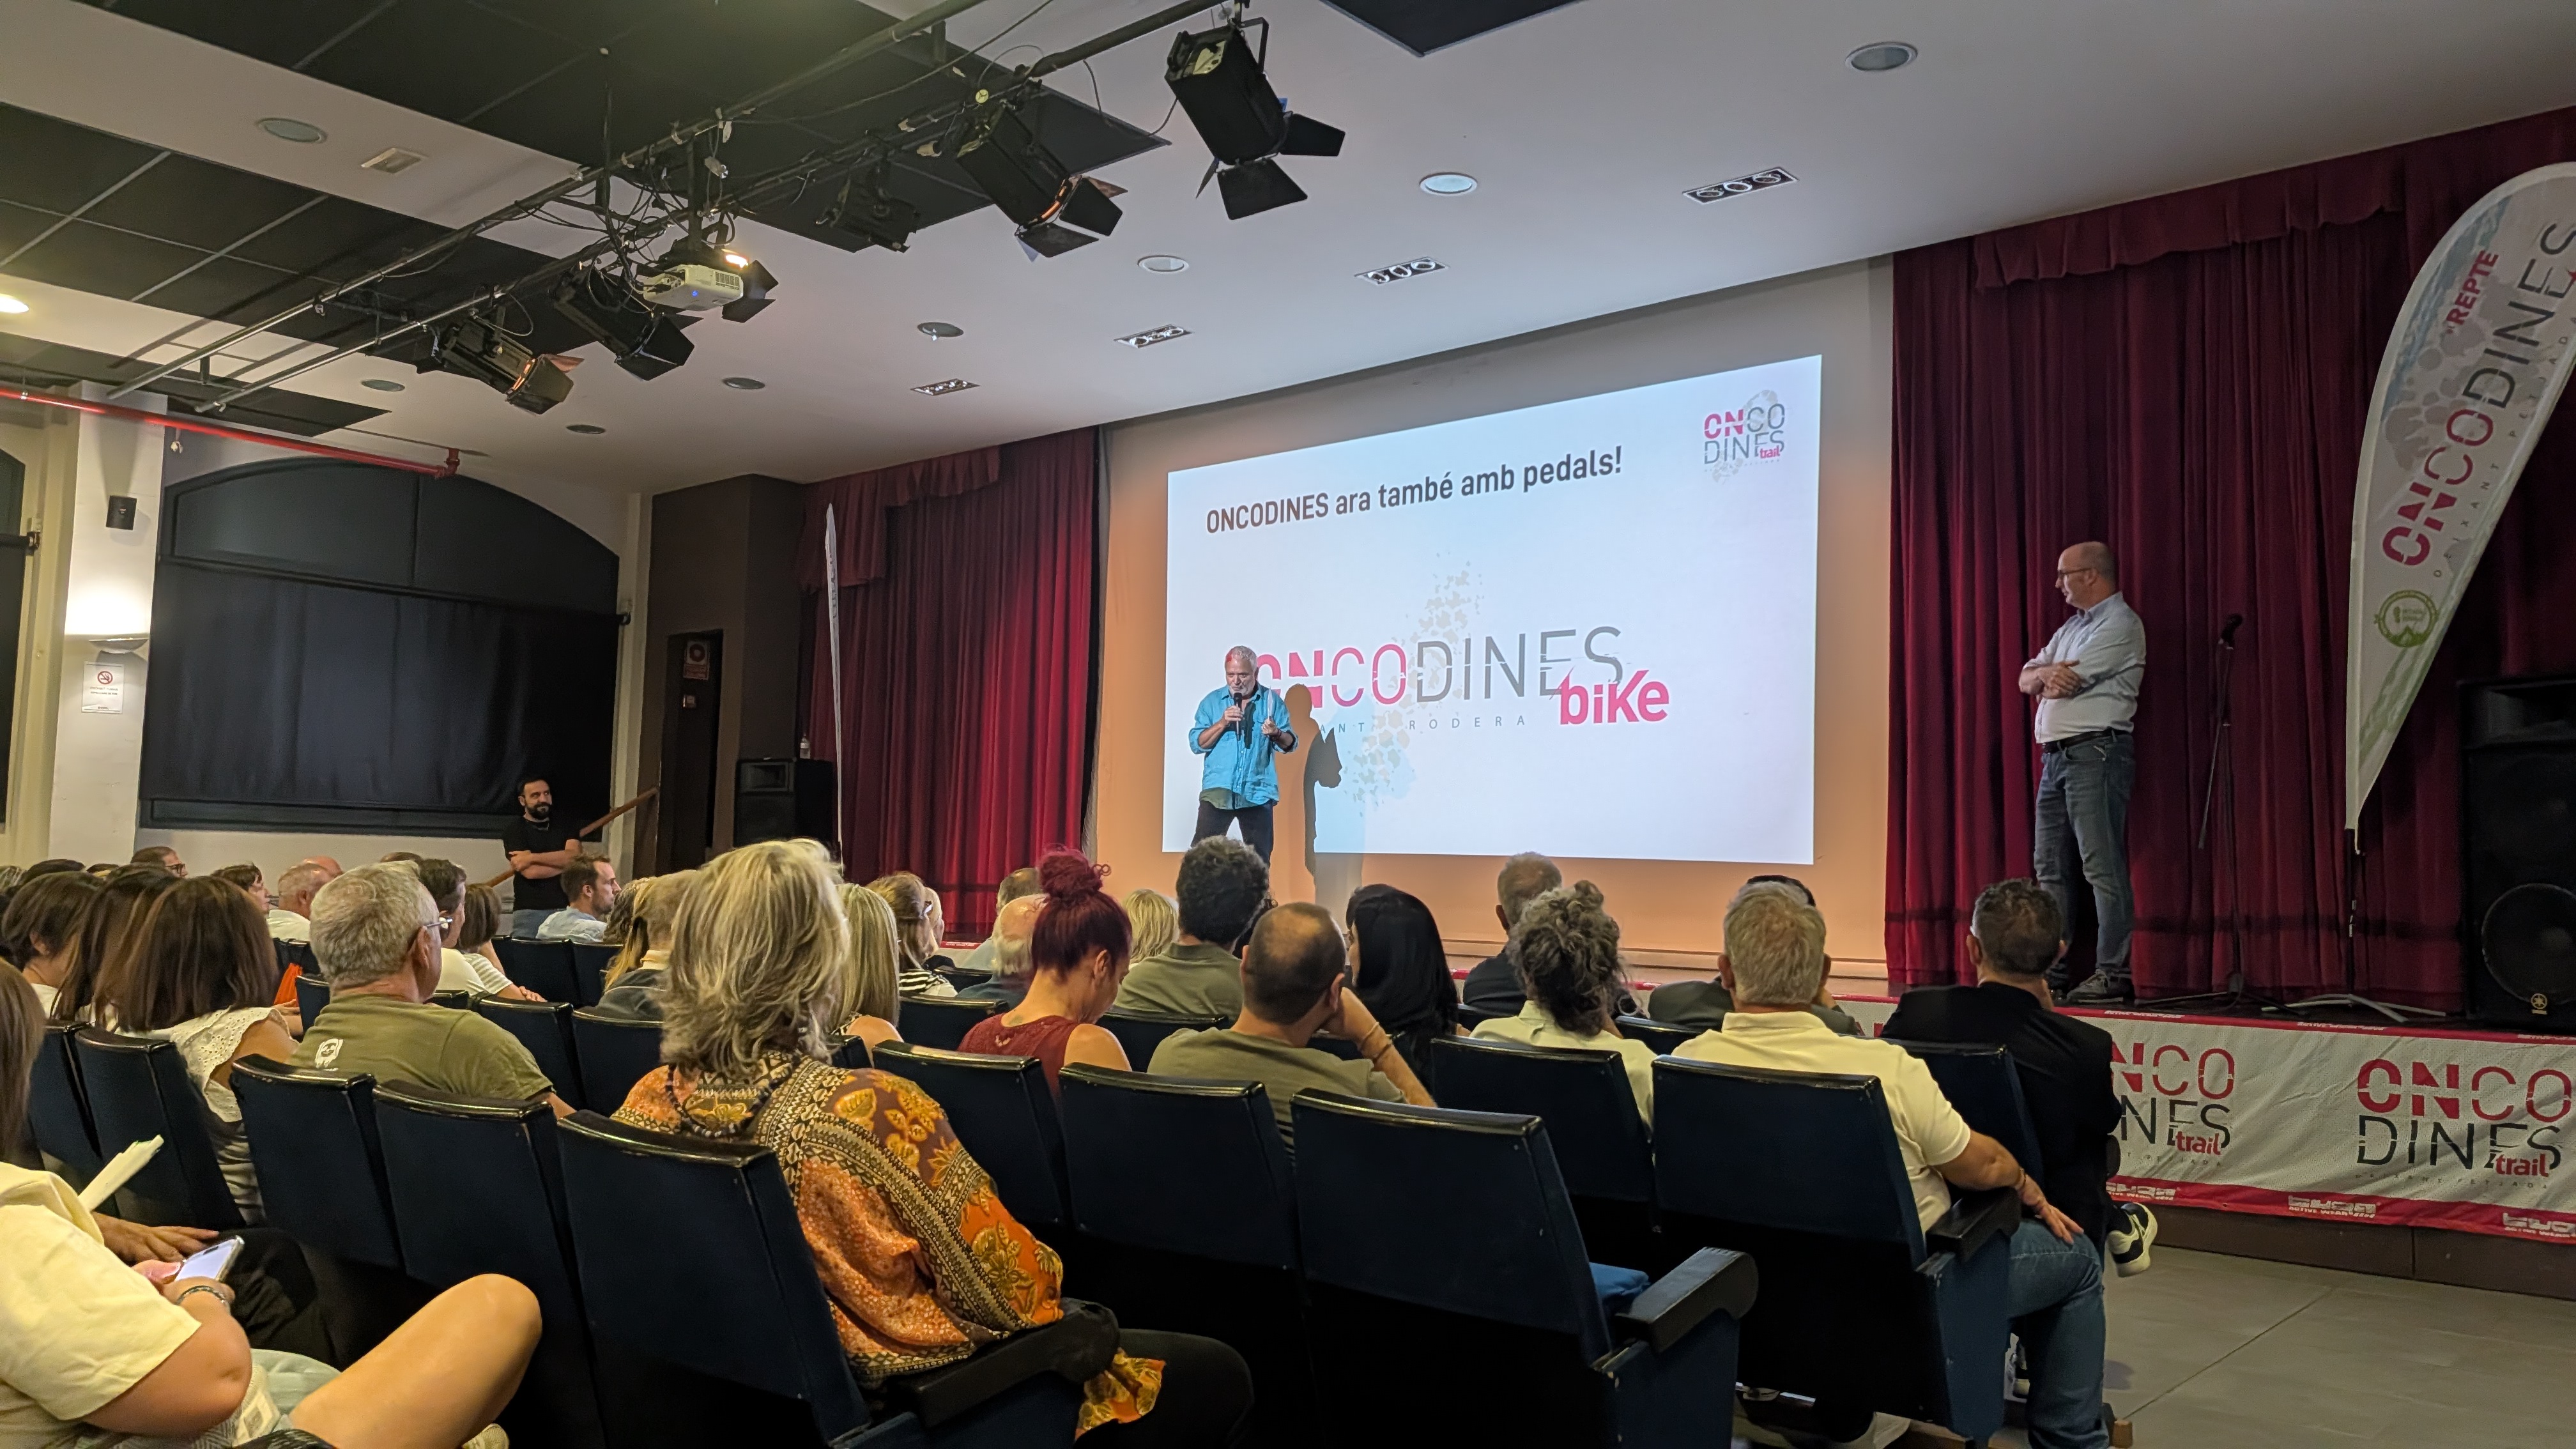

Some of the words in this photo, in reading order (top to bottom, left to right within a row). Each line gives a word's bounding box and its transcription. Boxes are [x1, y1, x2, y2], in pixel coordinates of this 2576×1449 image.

[2446, 250, 2499, 325] REPTE
[1704, 403, 1785, 440] ONCO
[1704, 430, 1784, 464] DINES
[1759, 445, 1781, 459] trail
[1206, 492, 1329, 534] ONCODINES
[1335, 491, 1372, 515] ara
[1377, 471, 1453, 509] també
[1460, 464, 1515, 496] amb
[1522, 445, 1623, 493] pedals!
[1408, 716, 1525, 730] RODERA
[2111, 1041, 2235, 1100] NCO
[2358, 1059, 2572, 1123] ONCO
[2120, 1094, 2231, 1149] NES
[2175, 1131, 2222, 1156] trail
[2357, 1115, 2561, 1170] DINES
[2496, 1153, 2550, 1177] trail
